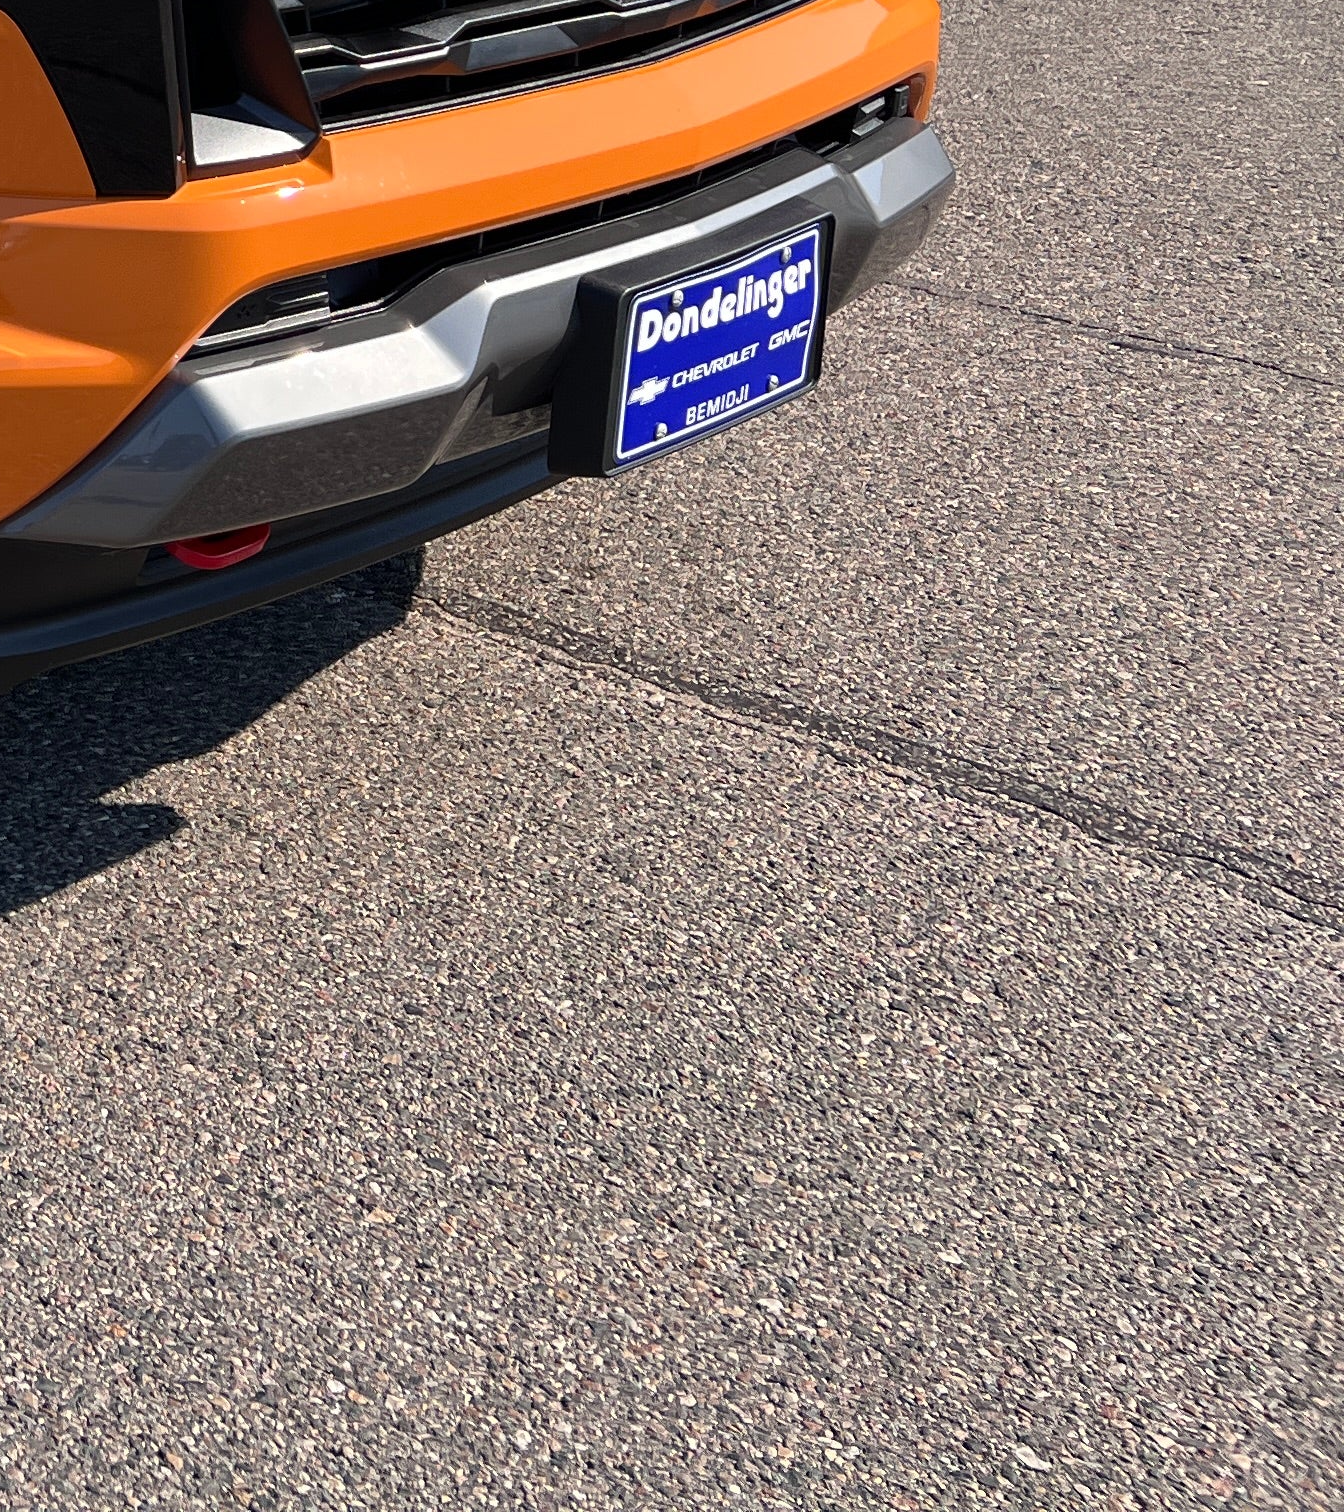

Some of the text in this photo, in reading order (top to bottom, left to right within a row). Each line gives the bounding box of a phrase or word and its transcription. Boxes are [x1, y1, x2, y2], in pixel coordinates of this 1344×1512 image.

[636, 258, 812, 353] Dondelinger
[671, 319, 811, 388] CHEVROLET GMC
[685, 383, 750, 426] BEMIDJI
